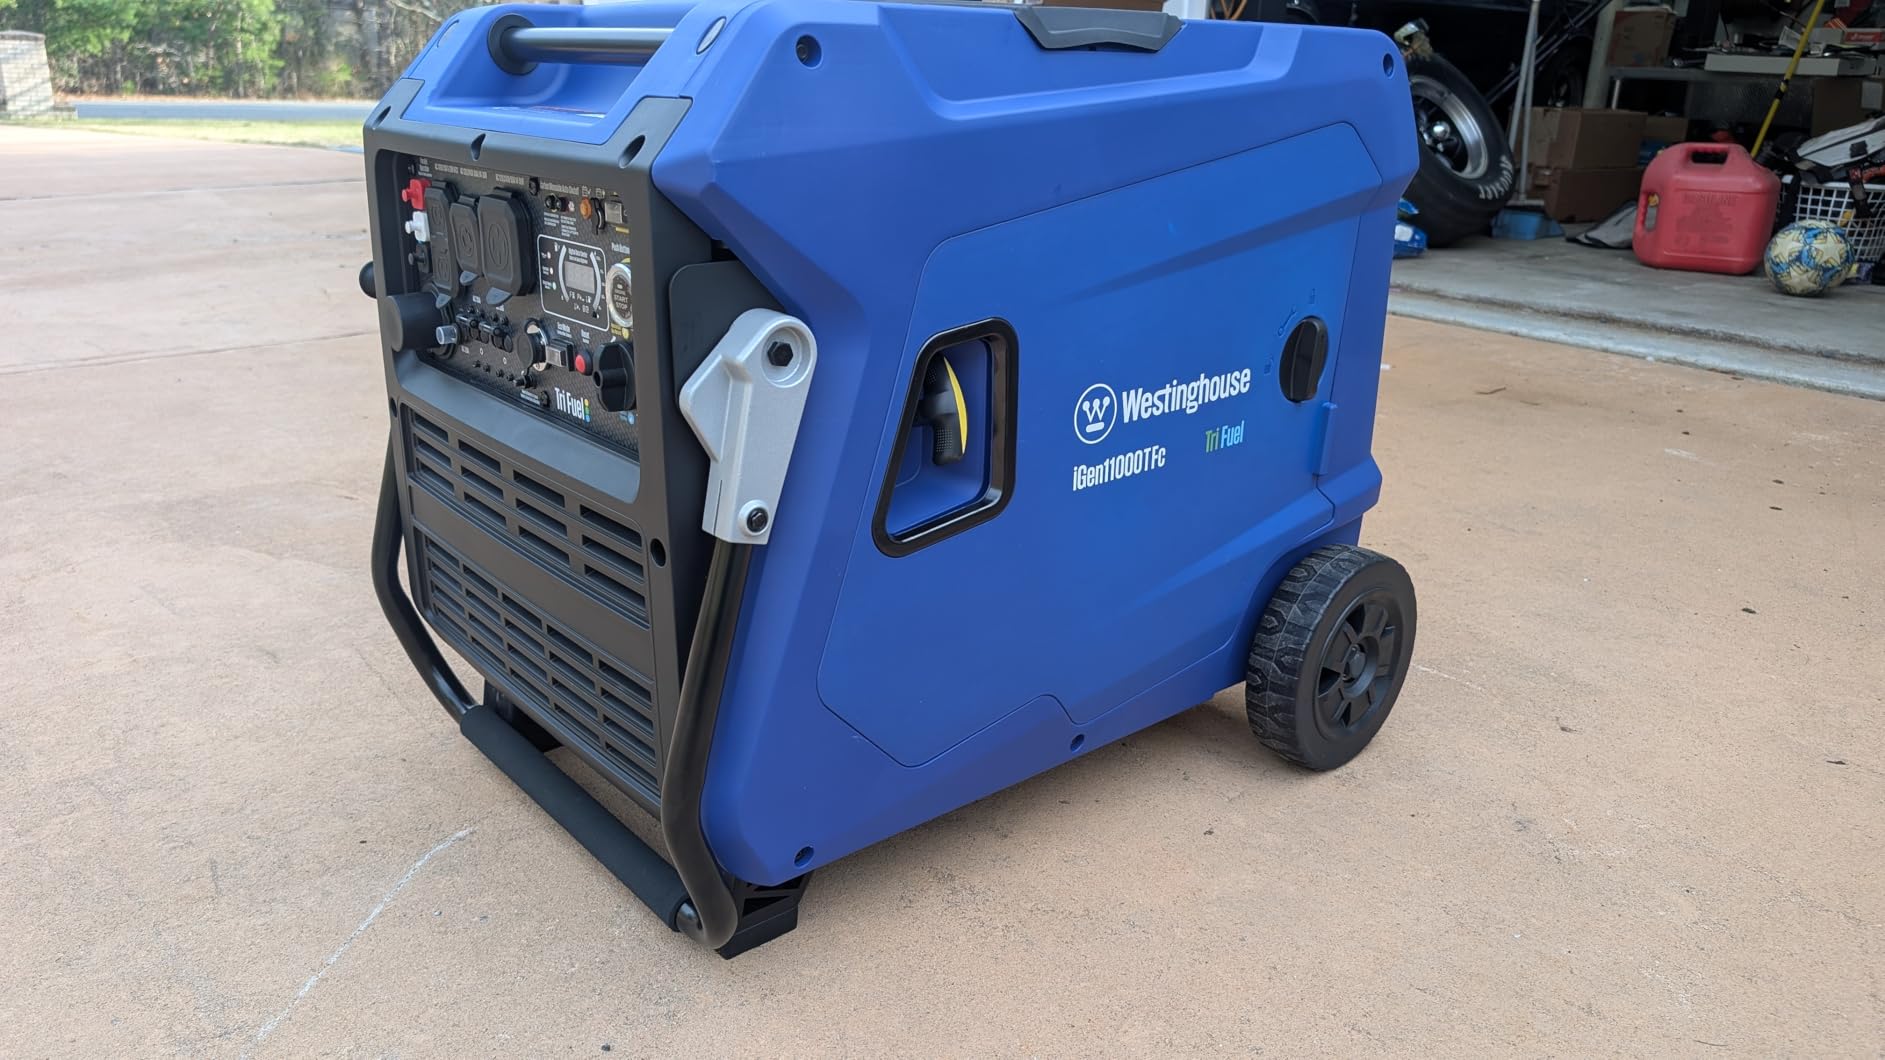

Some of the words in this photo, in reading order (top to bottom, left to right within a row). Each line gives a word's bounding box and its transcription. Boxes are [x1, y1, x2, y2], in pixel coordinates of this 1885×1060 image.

[554, 387, 566, 412] Tri
[566, 391, 585, 420] Fuel
[1121, 367, 1251, 424] Westinghouse
[1205, 430, 1220, 453] Tri
[1220, 420, 1245, 449] Fuel
[1072, 444, 1166, 491] iGen11000TFc
